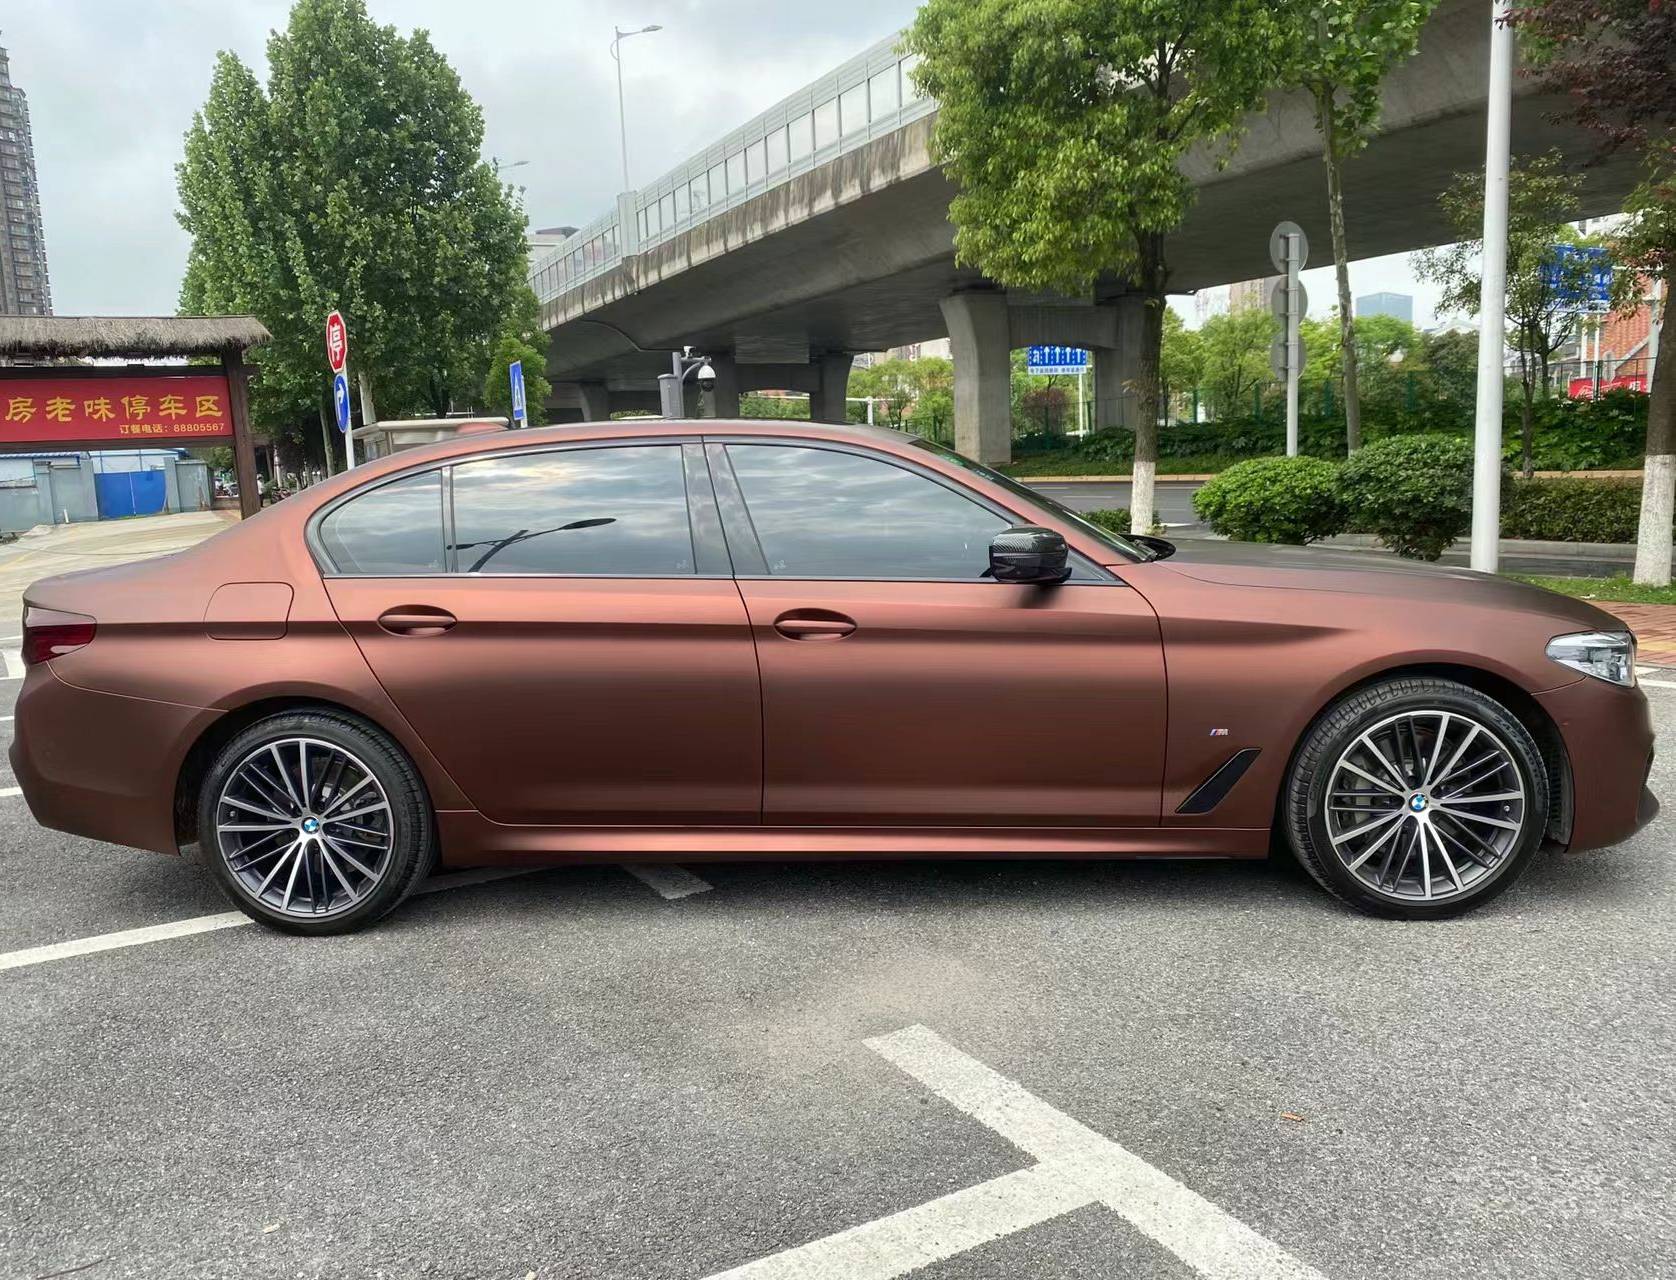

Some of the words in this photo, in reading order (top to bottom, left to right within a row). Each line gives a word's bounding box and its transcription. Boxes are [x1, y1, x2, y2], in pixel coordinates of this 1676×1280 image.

[5, 394, 223, 424] 房老味停车区
